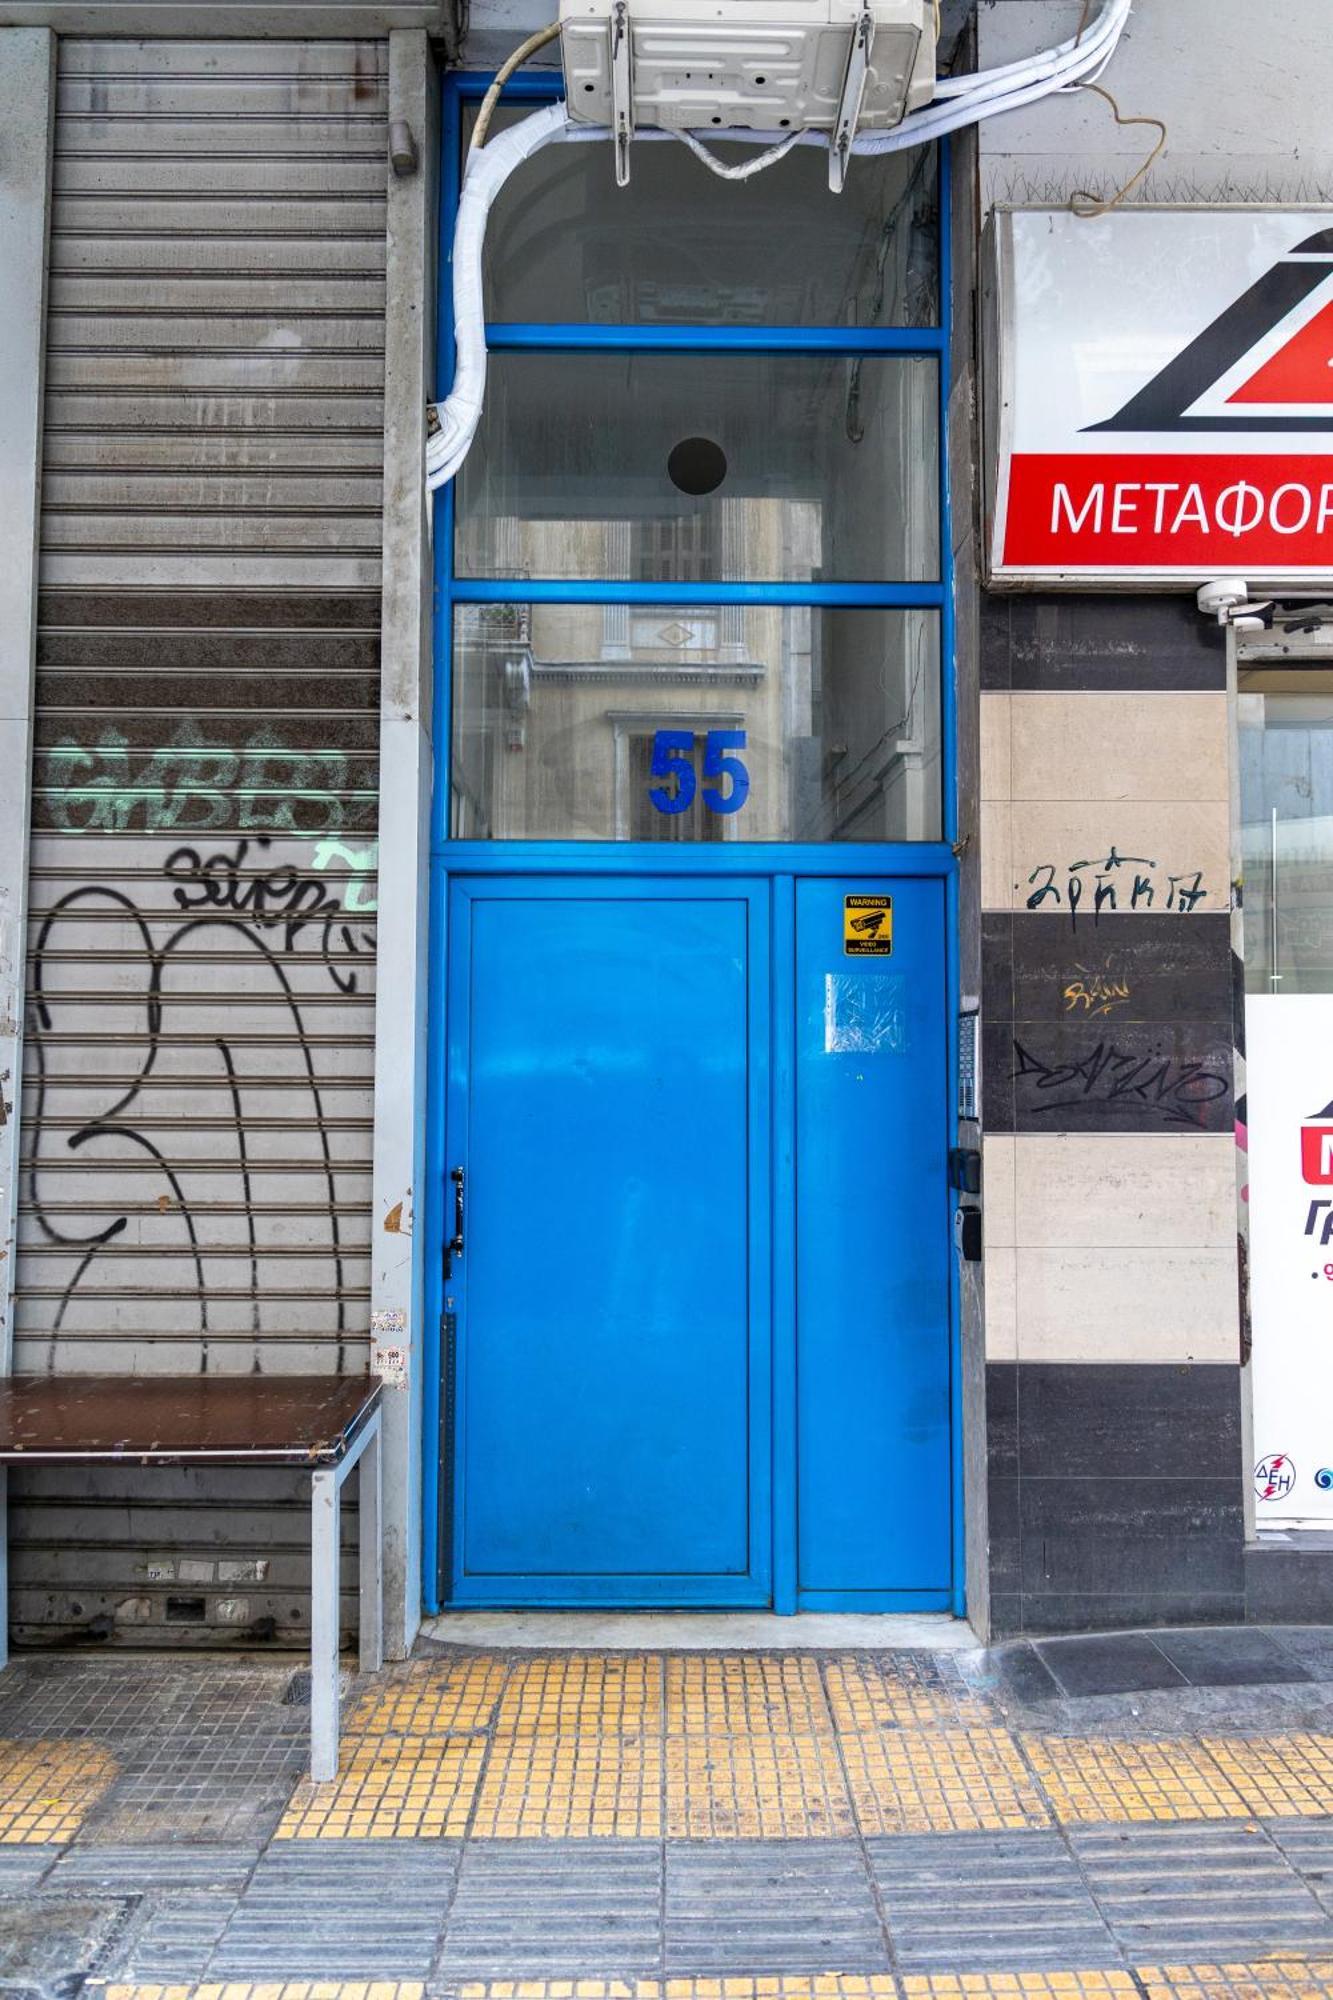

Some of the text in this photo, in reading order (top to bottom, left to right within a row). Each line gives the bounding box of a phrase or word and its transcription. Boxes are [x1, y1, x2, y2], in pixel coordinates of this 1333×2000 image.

[648, 730, 750, 814] 55
[850, 898, 887, 906] WARNING
[1256, 1465, 1291, 1491] ΔΕΗ
